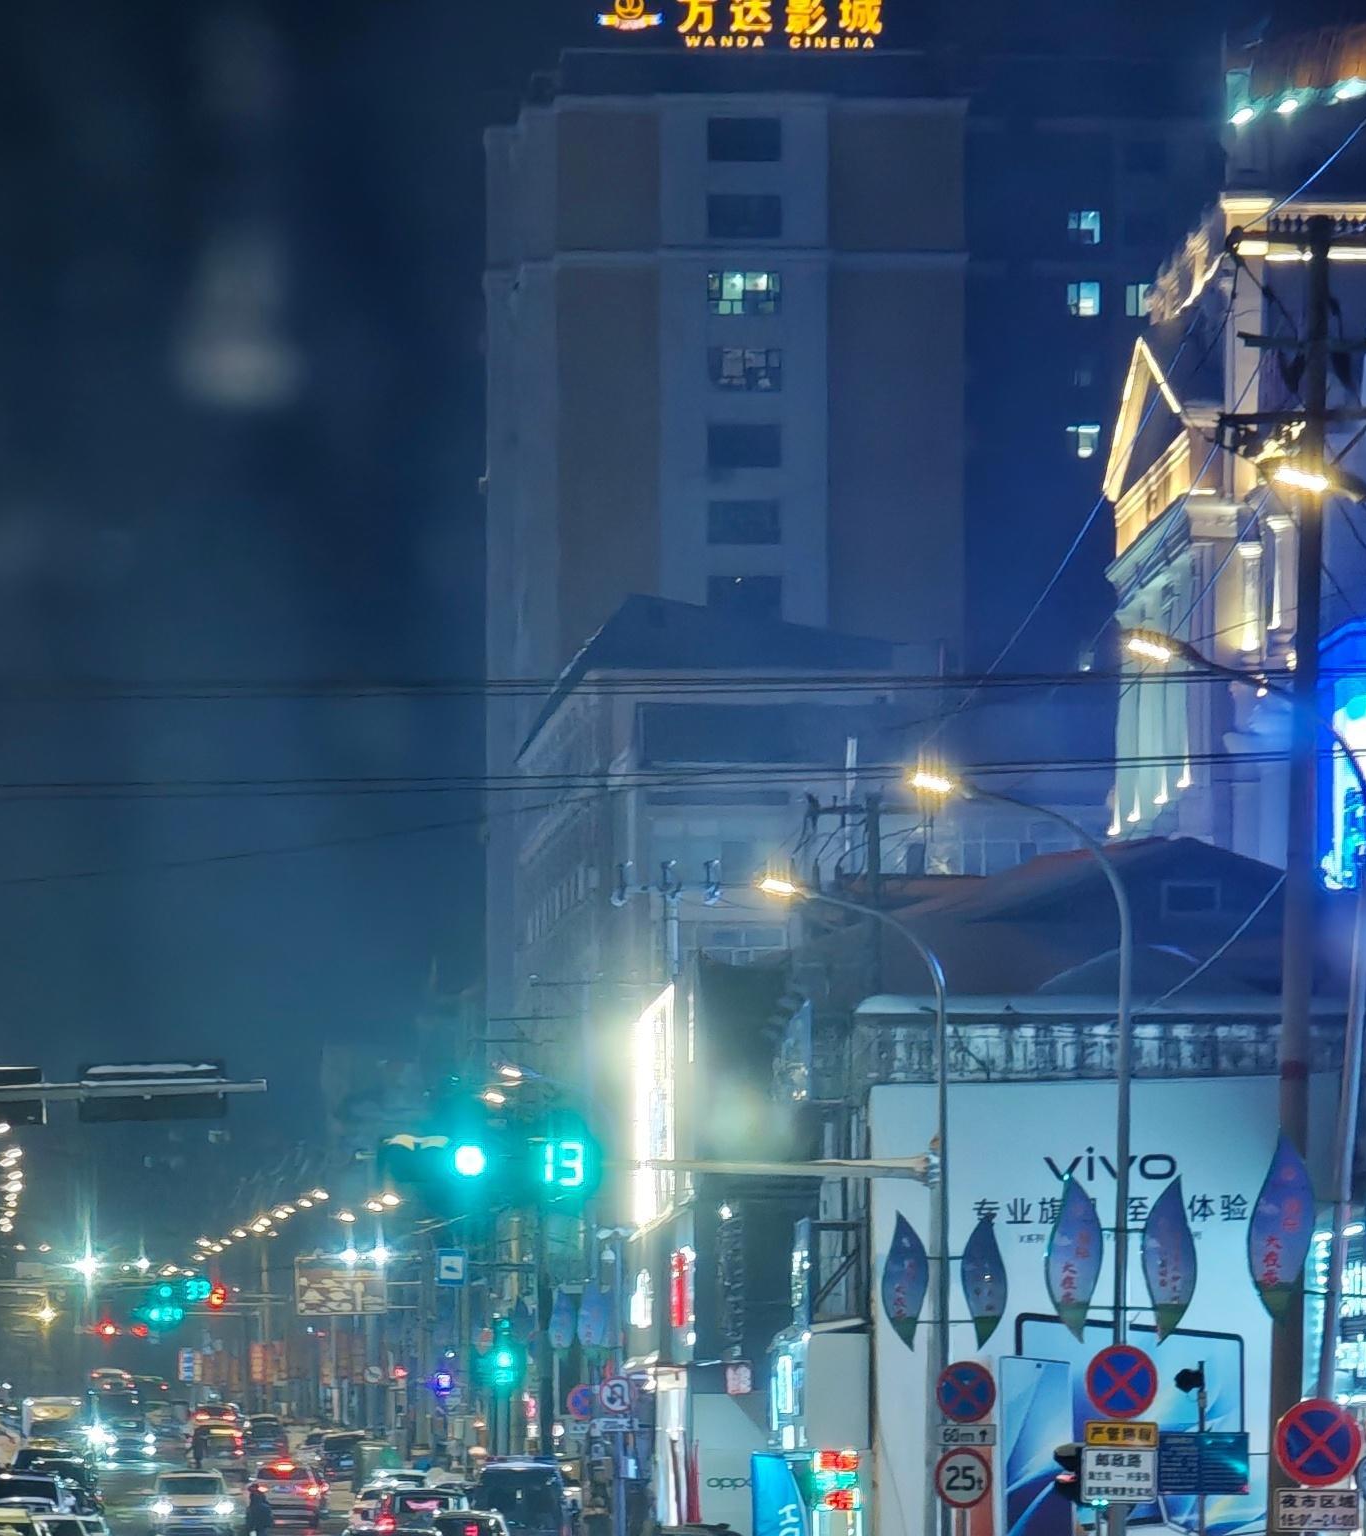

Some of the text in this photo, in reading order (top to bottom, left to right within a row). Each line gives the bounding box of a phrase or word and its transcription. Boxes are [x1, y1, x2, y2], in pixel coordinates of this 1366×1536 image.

[677, 0, 884, 33] 万达影城
[685, 35, 875, 49] WANDA CINEMA
[544, 1141, 584, 1187] 13
[1043, 1146, 1178, 1182] vivo
[1128, 1193, 1249, 1222] 至体验
